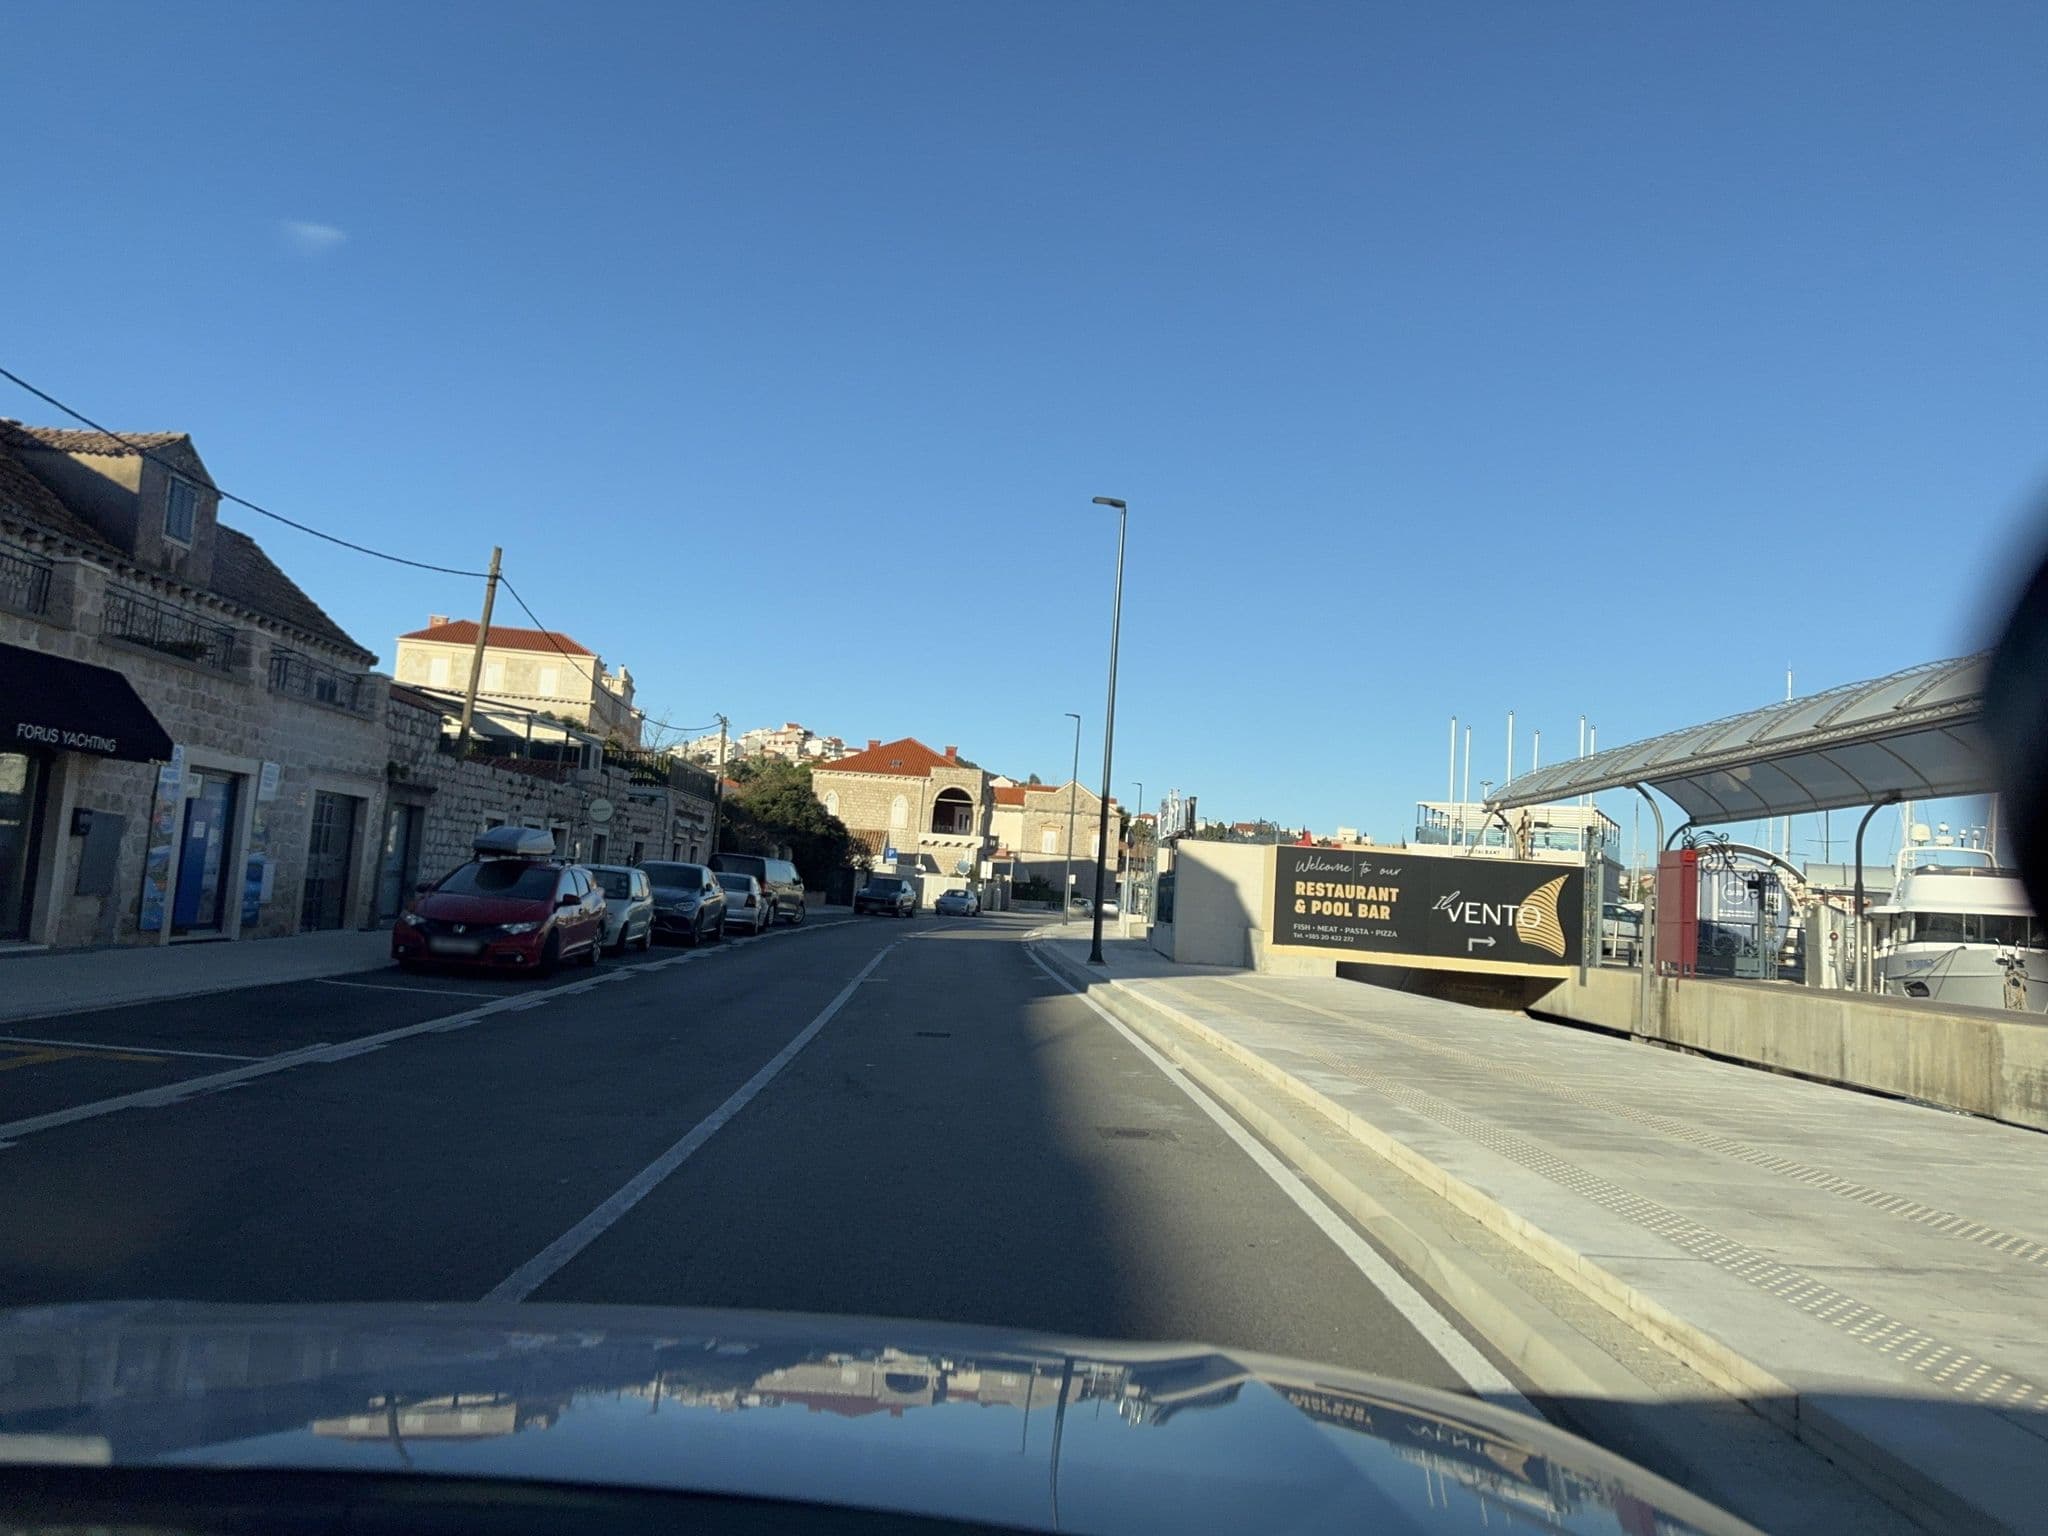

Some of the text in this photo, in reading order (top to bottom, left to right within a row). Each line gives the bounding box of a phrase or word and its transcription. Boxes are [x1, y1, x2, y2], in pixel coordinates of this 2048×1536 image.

[16, 723, 117, 752] FORUS YACHTING
[1295, 855, 1402, 878] Welcome to our
[1295, 881, 1399, 902] RESTAURANT
[1294, 899, 1391, 920] & POOL BAR
[1447, 901, 1541, 928] VENTO
[1293, 923, 1398, 938] FISH MEAT PASTA PIZZA
